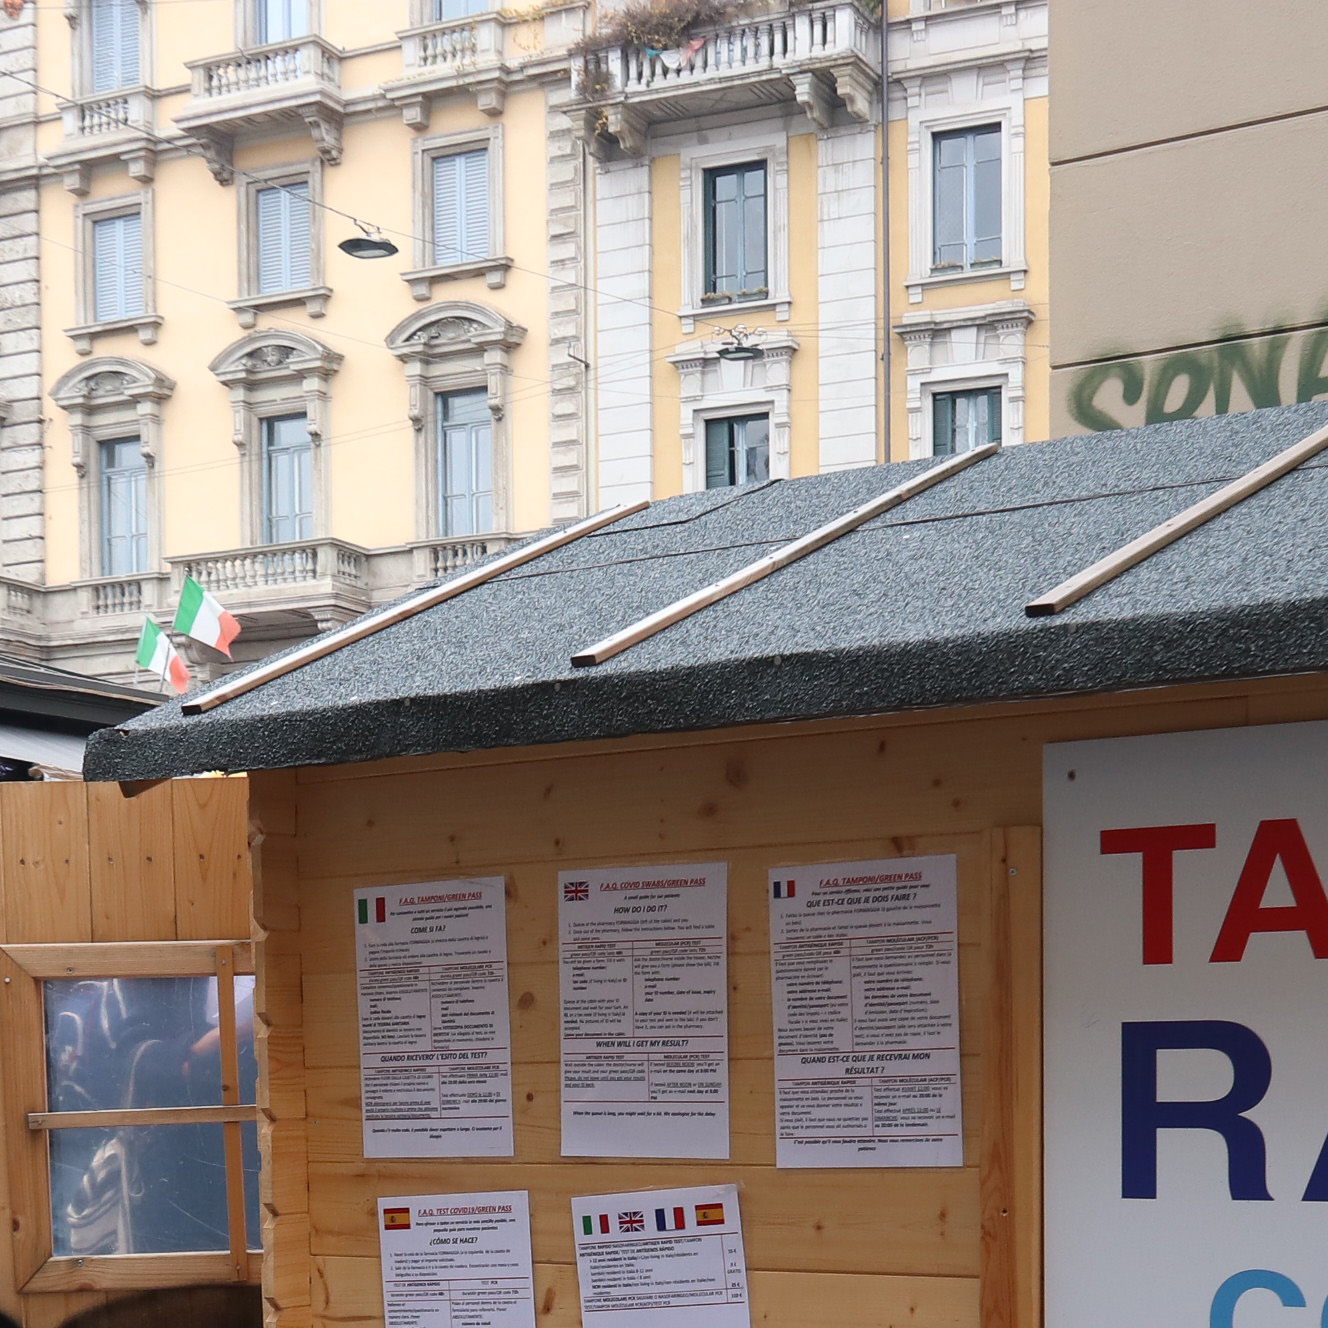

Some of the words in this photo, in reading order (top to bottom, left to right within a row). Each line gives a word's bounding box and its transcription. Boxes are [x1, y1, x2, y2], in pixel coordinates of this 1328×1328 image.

[600, 882, 618, 890] F.A.Q.
[620, 881, 640, 889] COVID
[641, 879, 688, 888] SWABS/GREEN
[690, 878, 705, 886] PASS
[842, 874, 903, 885] TAMPONI/GREEN
[904, 872, 922, 880] PASS
[417, 893, 466, 903] TAMPONI/GREEN
[467, 892, 481, 900] PASS
[807, 900, 821, 908] QUE
[823, 898, 844, 907] EST-CE
[847, 897, 861, 905] QUE
[872, 895, 889, 903] DOIS
[891, 894, 910, 902] FAIRE
[912, 893, 916, 901] ?
[646, 905, 656, 913] DO
[411, 926, 428, 934] COME
[430, 925, 434, 933] SI
[801, 1056, 826, 1064] QUAND
[828, 1055, 850, 1063] EST-CE
[877, 1053, 910, 1061] RECEVRAI
[450, 1206, 496, 1214] COVID19/GREEN
